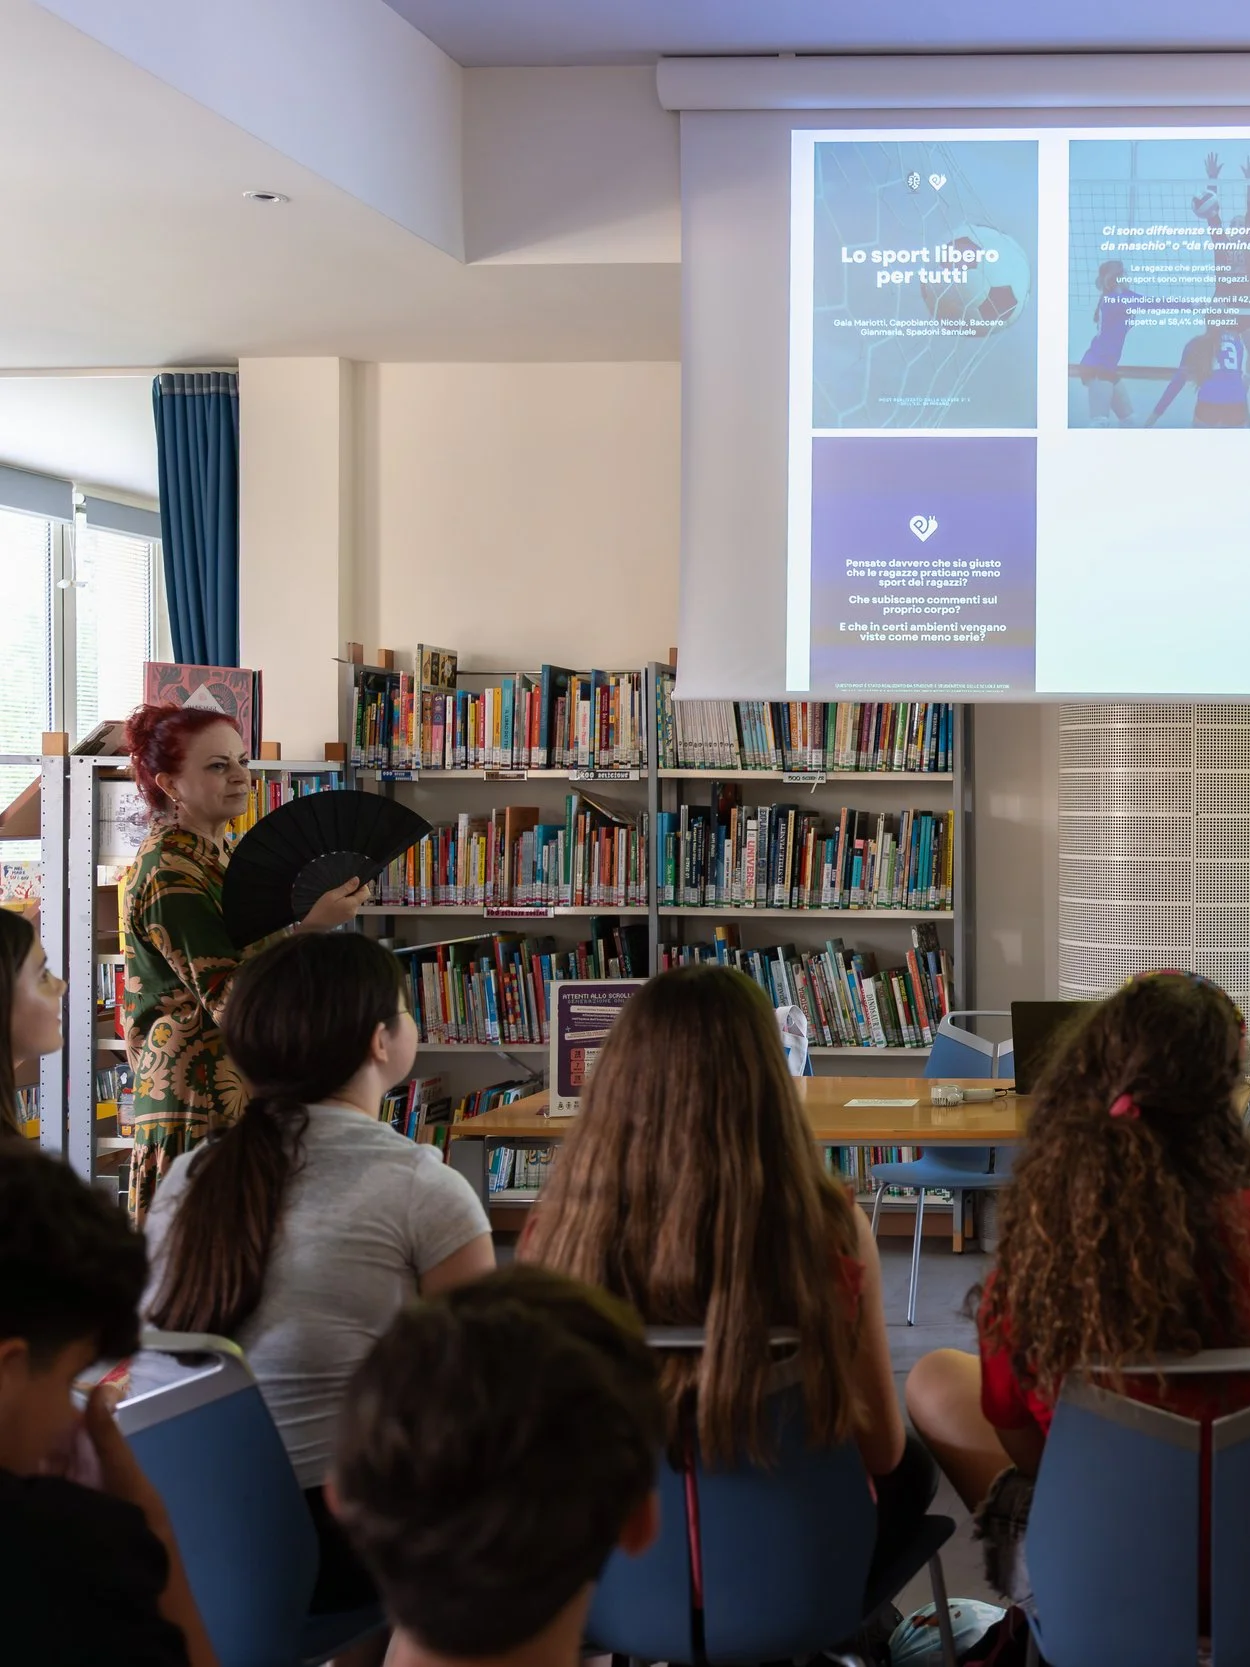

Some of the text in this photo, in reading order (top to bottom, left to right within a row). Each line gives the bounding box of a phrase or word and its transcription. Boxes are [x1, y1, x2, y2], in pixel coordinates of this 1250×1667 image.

[1102, 226, 1115, 236] Ci
[1117, 227, 1144, 236] sono
[1146, 224, 1205, 236] differenze
[1206, 226, 1223, 236] tra
[1100, 241, 1116, 251] da
[1172, 242, 1180, 250] o
[841, 244, 999, 267] Lo sport libero
[1141, 265, 1173, 274] ragazze
[1191, 264, 1231, 273] praticano
[876, 265, 968, 288] per tutti
[1133, 276, 1156, 285] sport
[1218, 275, 1249, 284] ragazzi.
[1103, 295, 1115, 303] Tra
[1121, 295, 1154, 305] quindici
[1166, 295, 1211, 304] diciassette
[1213, 295, 1231, 303] anni
[1147, 308, 1179, 316] ragazze
[1192, 306, 1222, 316] pratica
[854, 319, 888, 328] Mariotti,
[889, 318, 938, 328] Capobianco
[940, 318, 968, 327] Nicole,
[970, 318, 1004, 327] Baccaro
[1124, 318, 1158, 327] rispetto
[1167, 318, 1192, 326] 58,4%
[1207, 318, 1238, 327] ragazzi.
[861, 328, 904, 337] Gianmaria,
[906, 328, 940, 337] Spadoni
[846, 559, 1001, 569] Pensate davvero che sia giusto
[878, 570, 918, 579] ragazze
[920, 569, 970, 579] praticano
[878, 578, 968, 588] sport dei ragazzi?
[849, 595, 997, 604] Che subiscano commenti sul
[883, 605, 961, 615] proprio corpo?
[839, 622, 1007, 634] E che in certi ambienti vengano
[860, 632, 886, 641] viste
[953, 632, 985, 642] serie?
[866, 994, 879, 1027] DINOSAUR
